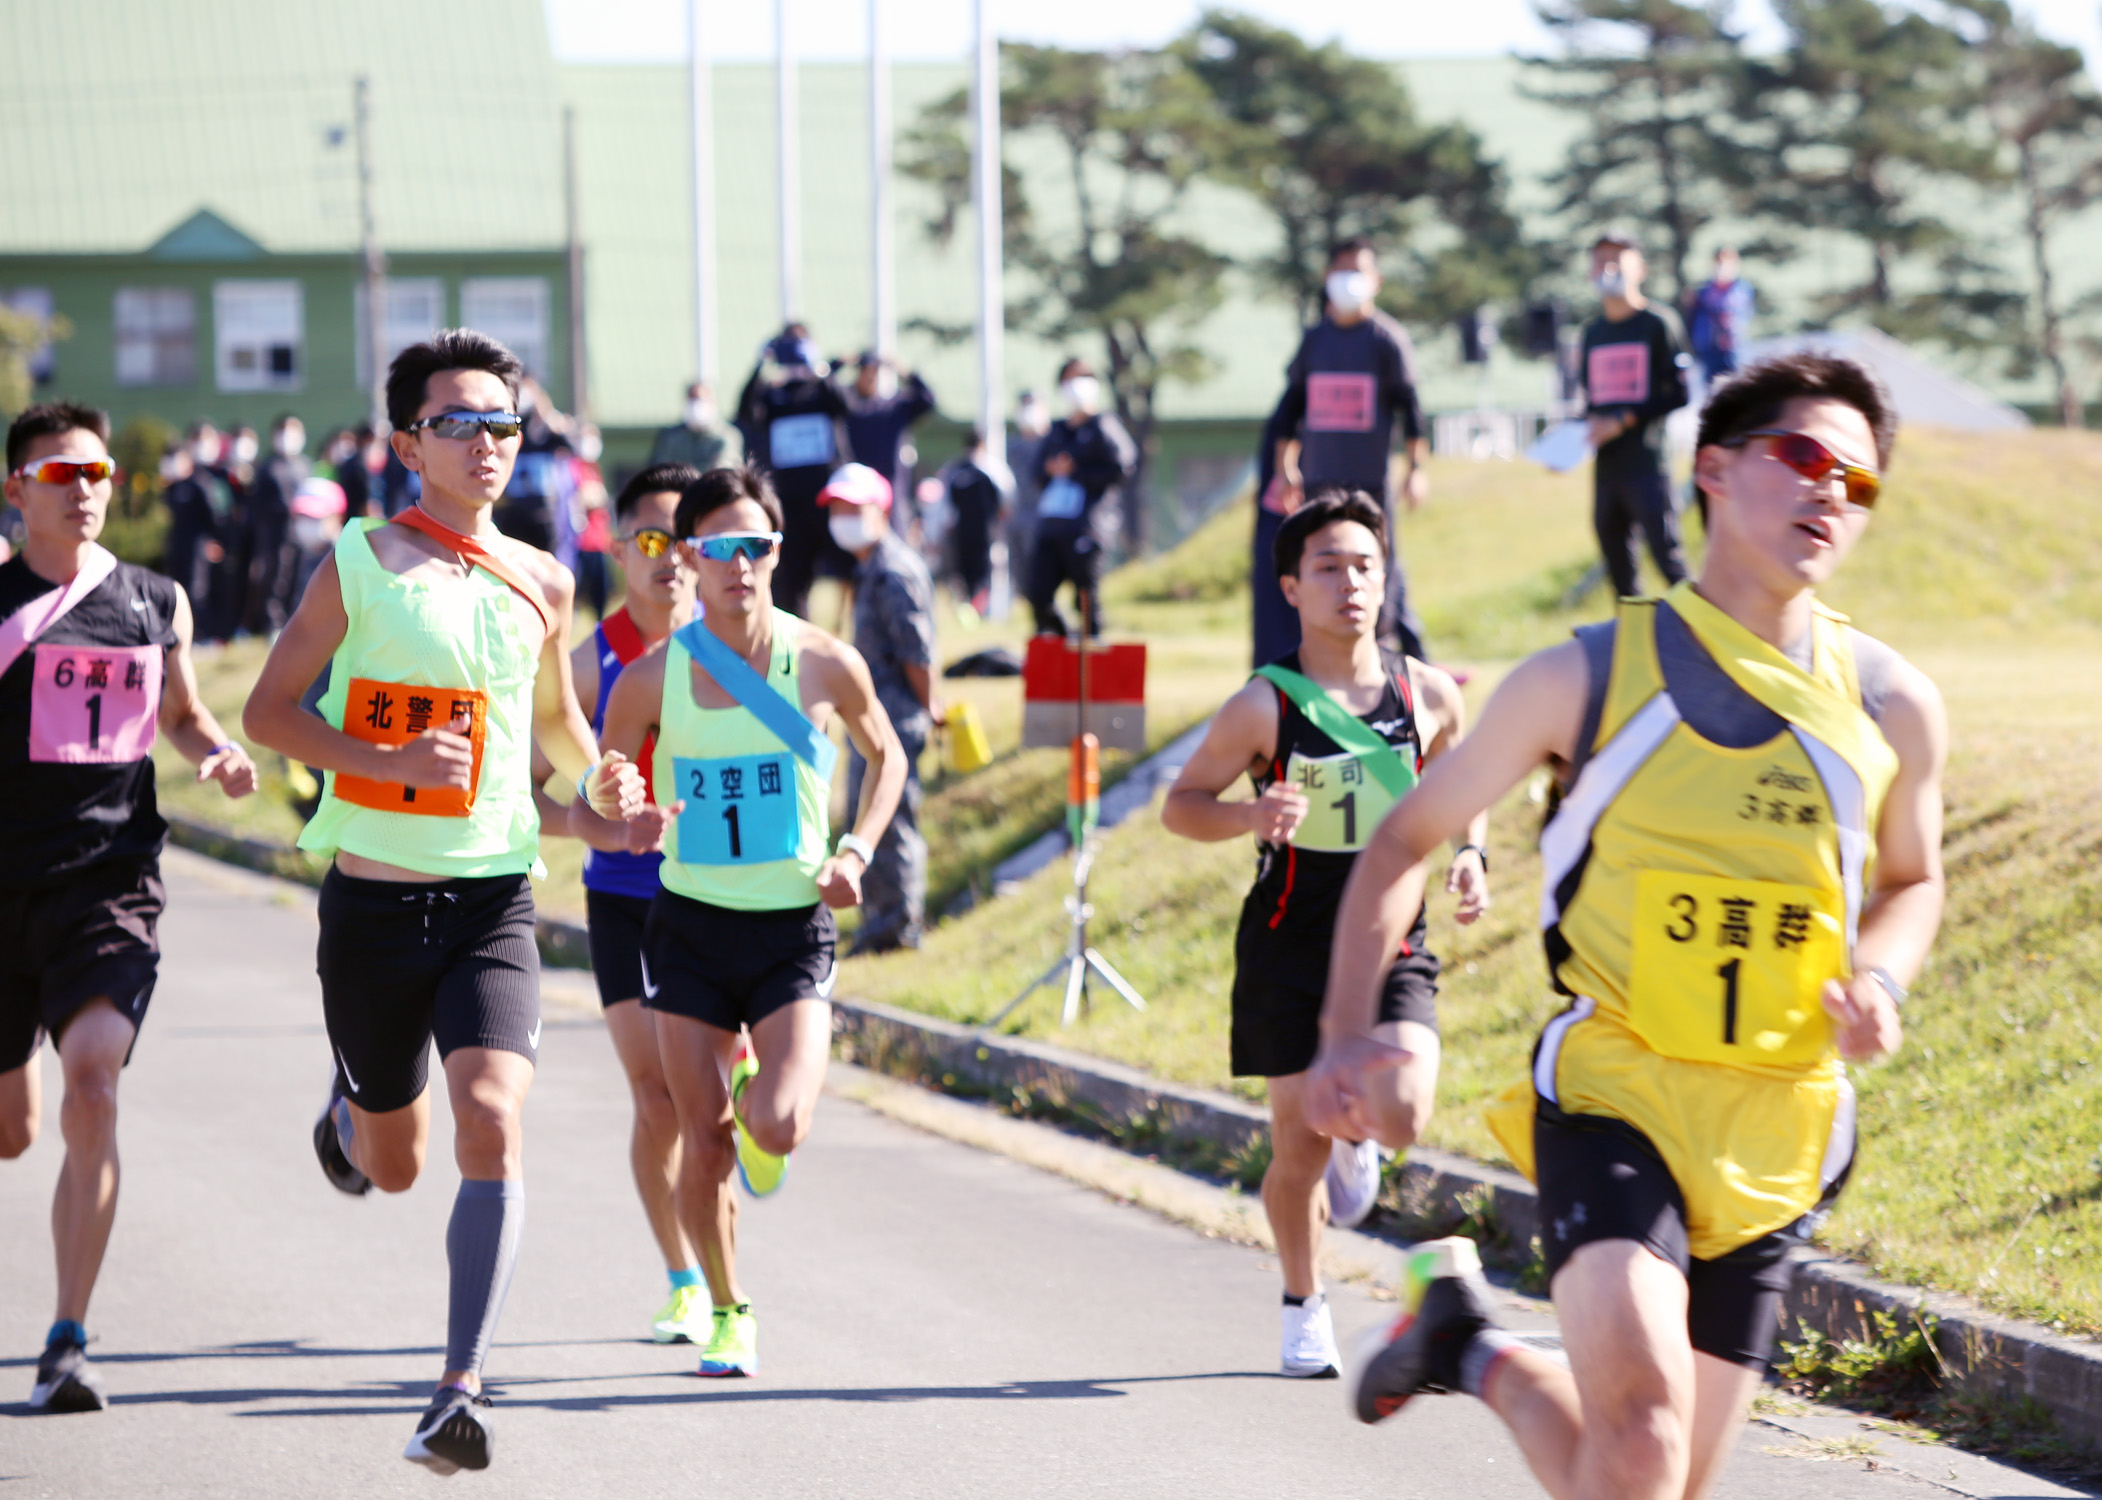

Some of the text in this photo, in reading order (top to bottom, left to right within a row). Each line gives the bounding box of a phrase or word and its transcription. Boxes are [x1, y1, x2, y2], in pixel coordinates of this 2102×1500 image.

[54, 658, 146, 691] 6高群
[85, 693, 102, 751] 1
[690, 762, 782, 799] 2空団
[722, 803, 743, 858] 1
[1330, 791, 1357, 845] 1
[1665, 893, 1812, 951] 3高群
[1716, 957, 1741, 1046] 1
